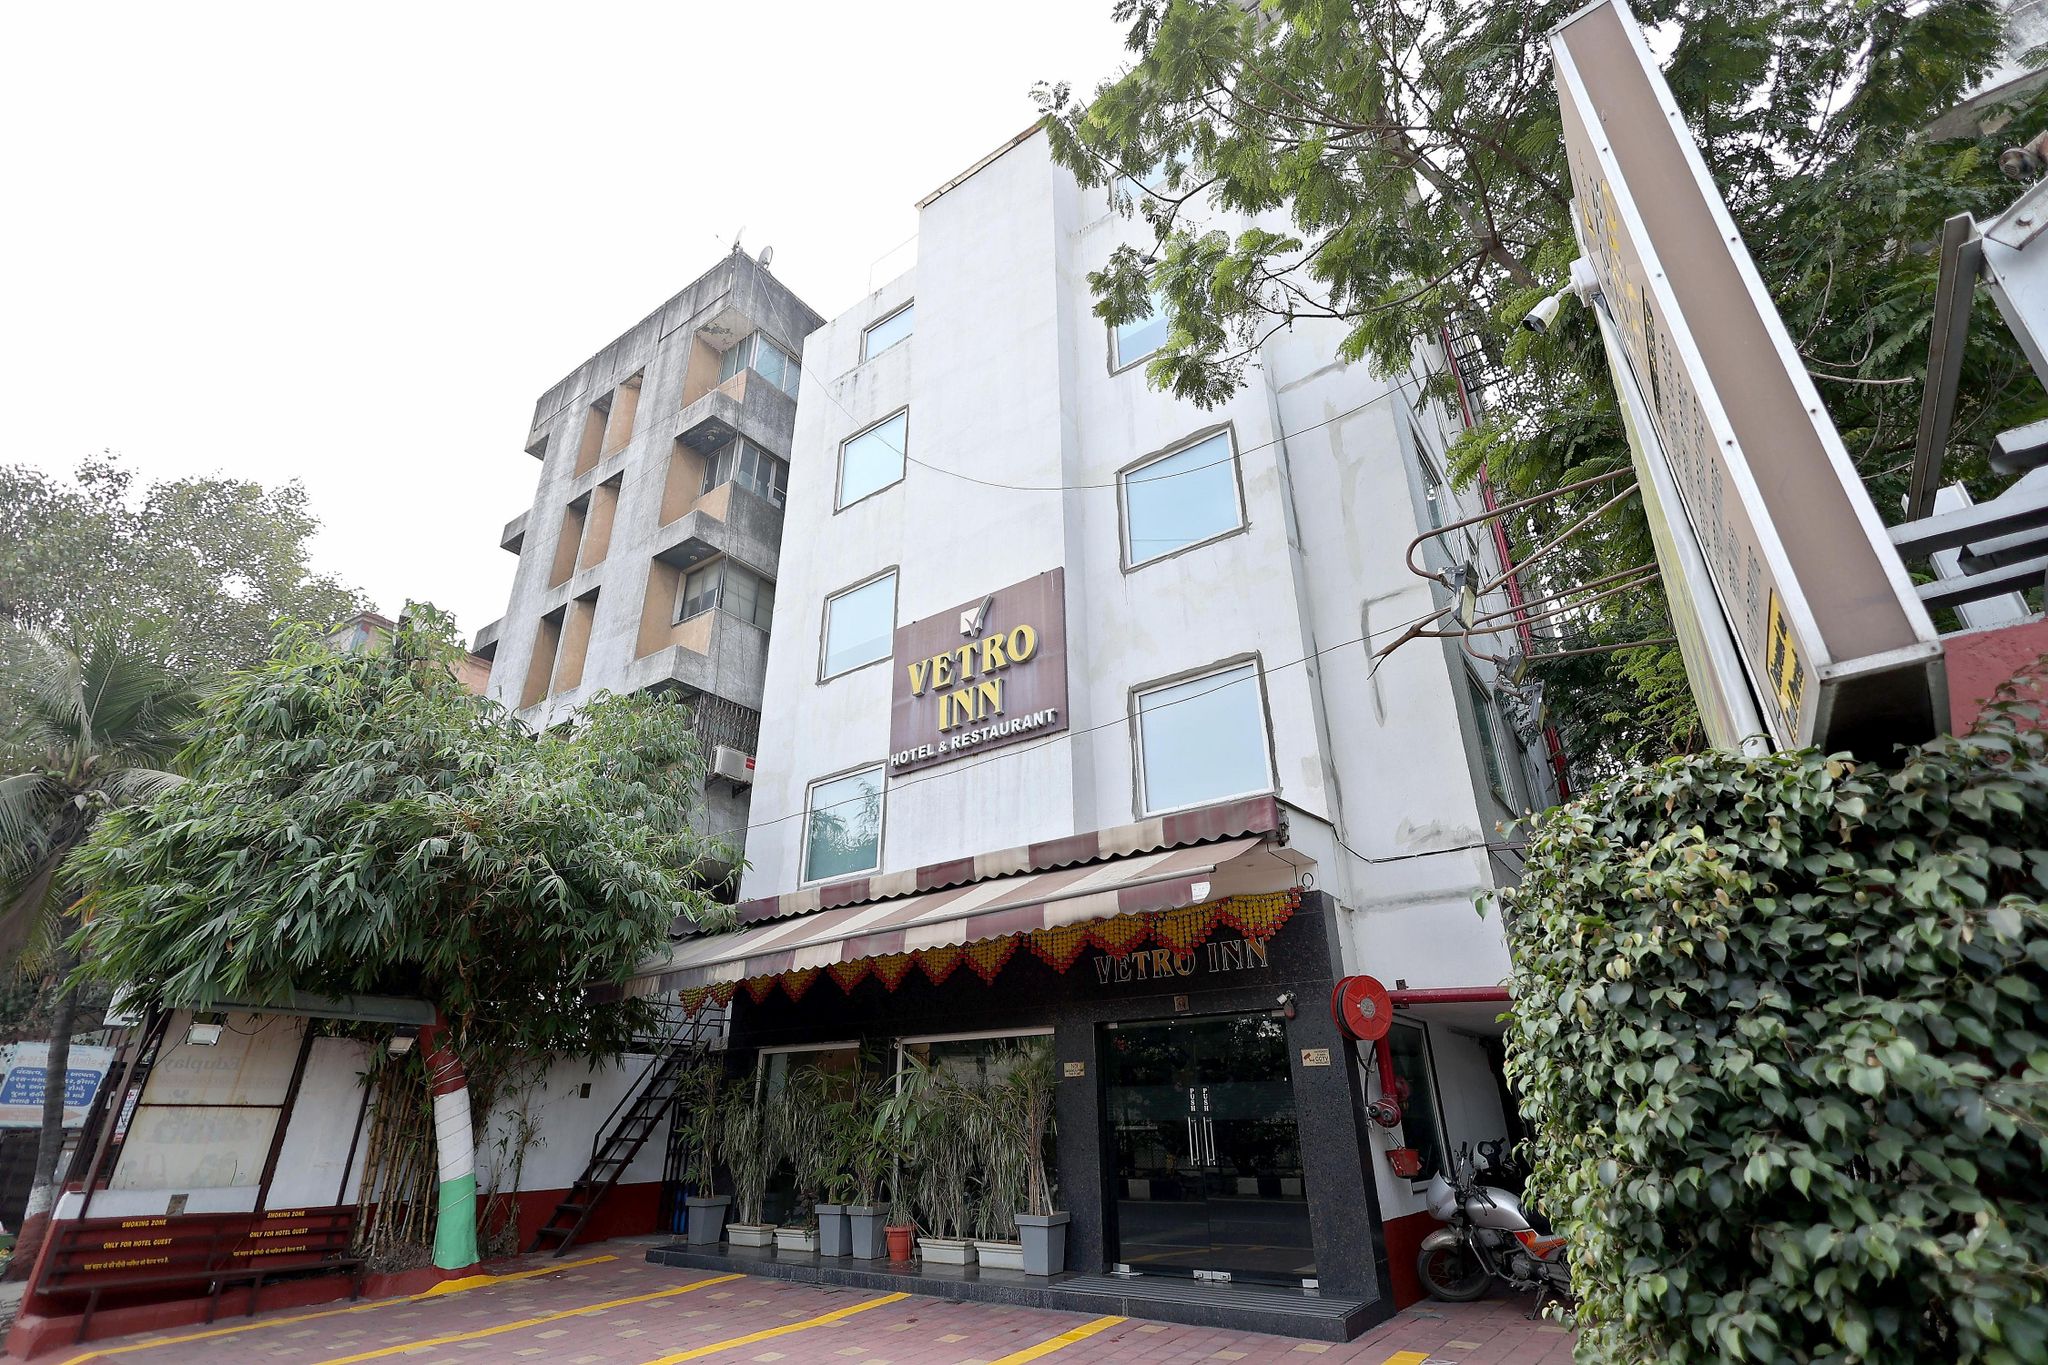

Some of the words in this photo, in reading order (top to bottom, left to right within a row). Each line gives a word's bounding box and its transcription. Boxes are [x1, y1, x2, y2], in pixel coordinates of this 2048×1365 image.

[907, 624, 1037, 697] VETRO
[938, 678, 1004, 732] INN
[890, 743, 938, 768] HOTEL
[938, 740, 950, 754] &
[950, 708, 1058, 751] RESTAURANT
[1094, 948, 1196, 984] VETRO
[1207, 937, 1269, 973] INN
[122, 1220, 150, 1228] SMOKING
[267, 1211, 290, 1219] SMOKING
[103, 1241, 118, 1249] ONLY
[153, 1238, 173, 1246] GUEST
[292, 1227, 308, 1235] GUEST
